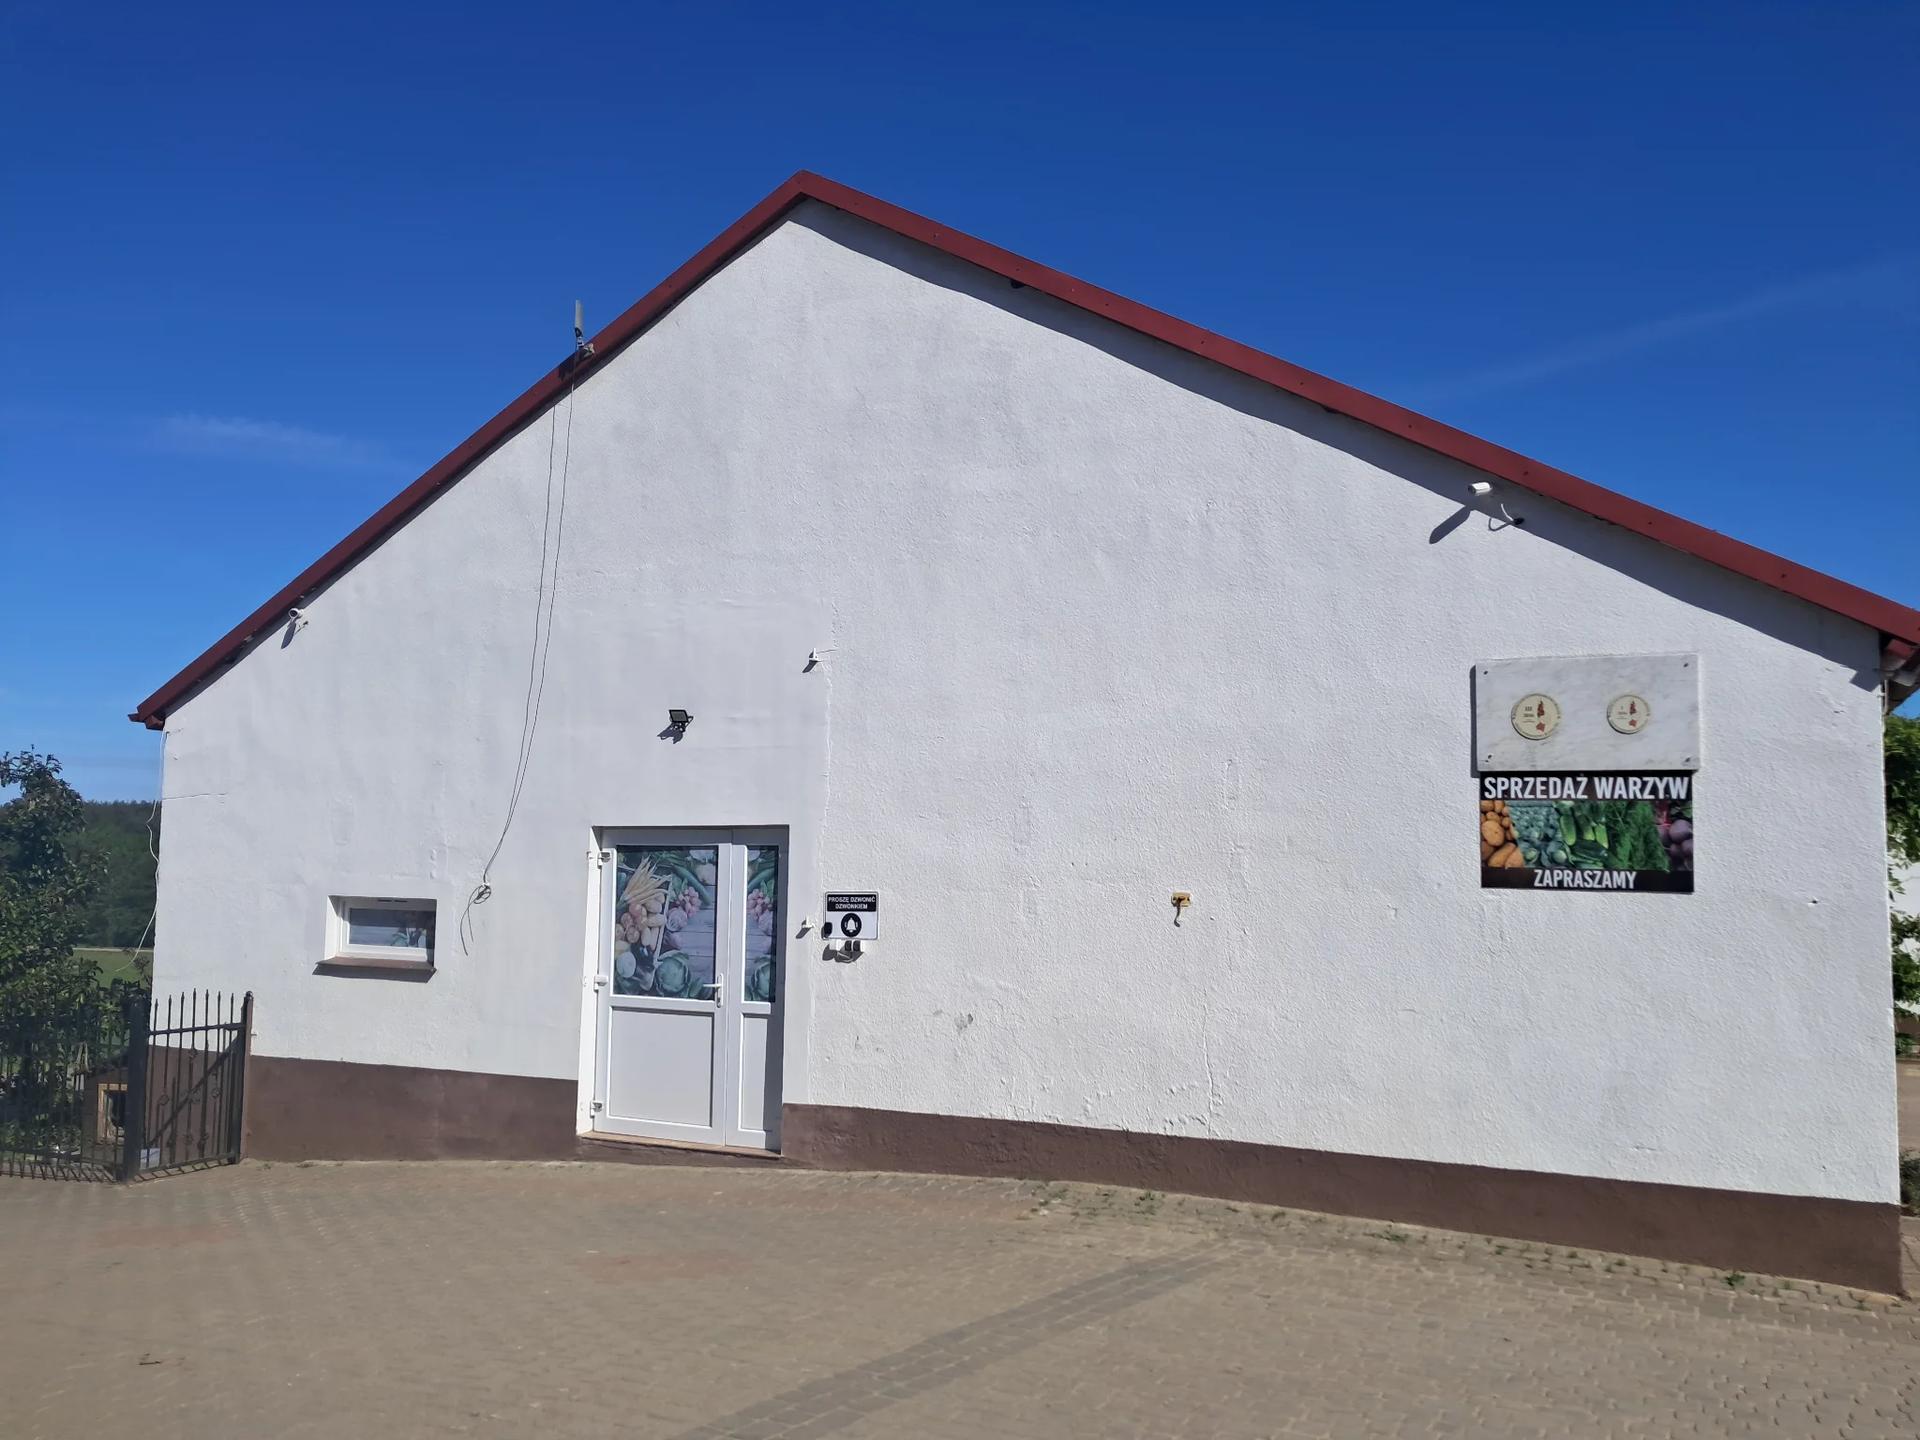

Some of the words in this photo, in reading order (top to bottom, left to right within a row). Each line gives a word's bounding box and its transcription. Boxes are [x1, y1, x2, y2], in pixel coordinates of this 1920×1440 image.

[1484, 773, 1588, 799] SPRZEDAŻ
[1594, 776, 1689, 799] WARZYW
[1534, 869, 1637, 889] ZAPRASZAMY
